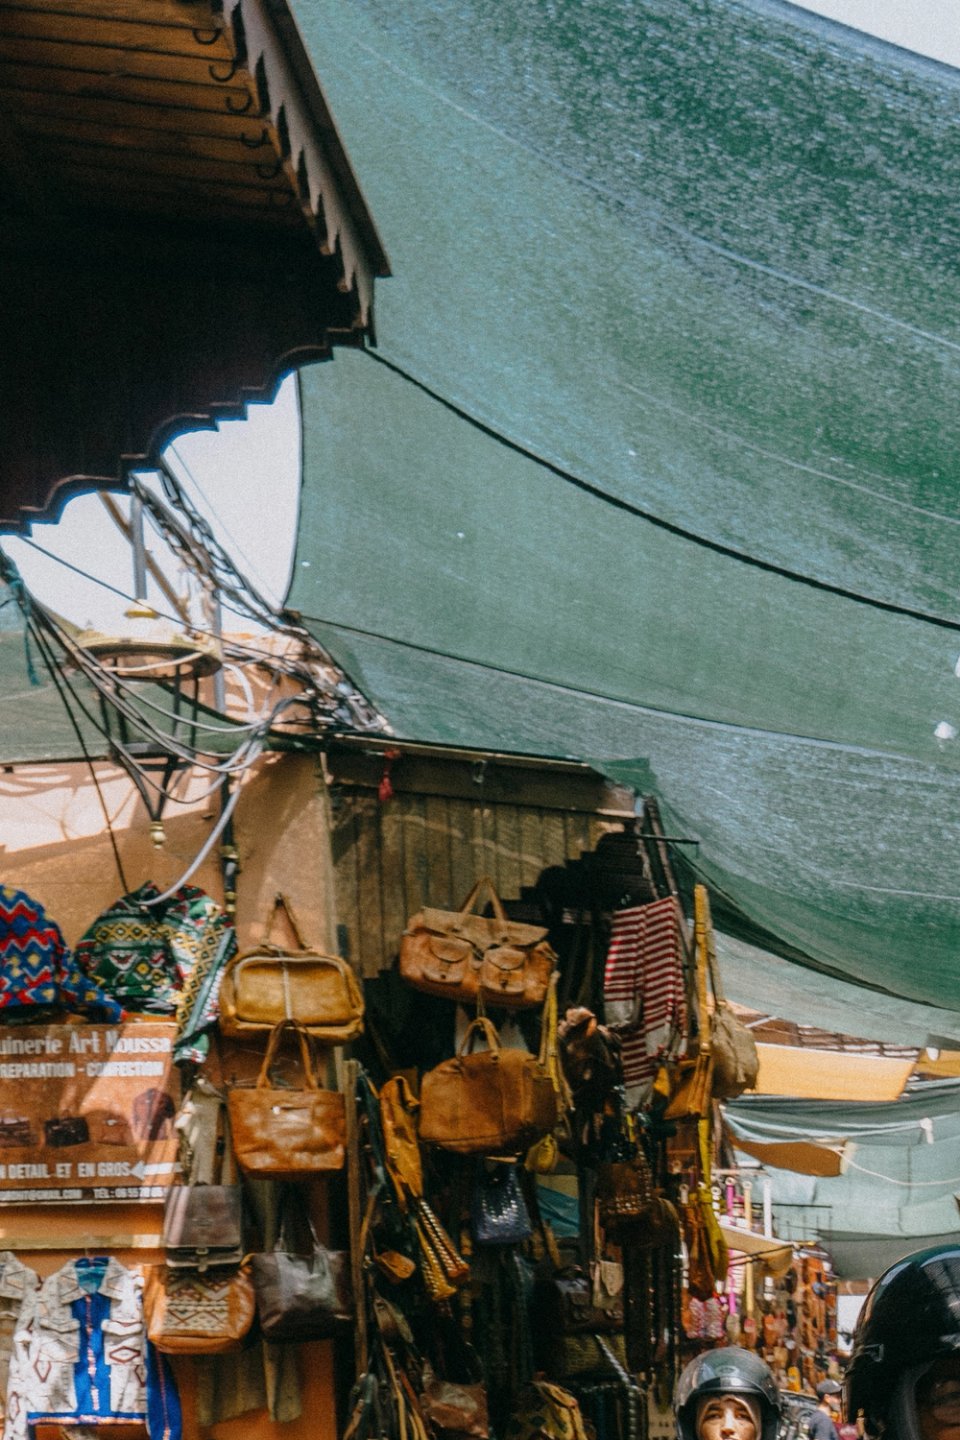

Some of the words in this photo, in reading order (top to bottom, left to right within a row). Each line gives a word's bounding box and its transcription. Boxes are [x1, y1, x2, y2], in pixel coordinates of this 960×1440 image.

[69, 1031, 99, 1054] Art
[105, 1030, 171, 1053] Moussa
[56, 1163, 72, 1178] ET
[77, 1162, 95, 1177] EN
[98, 1161, 131, 1177] GROS
